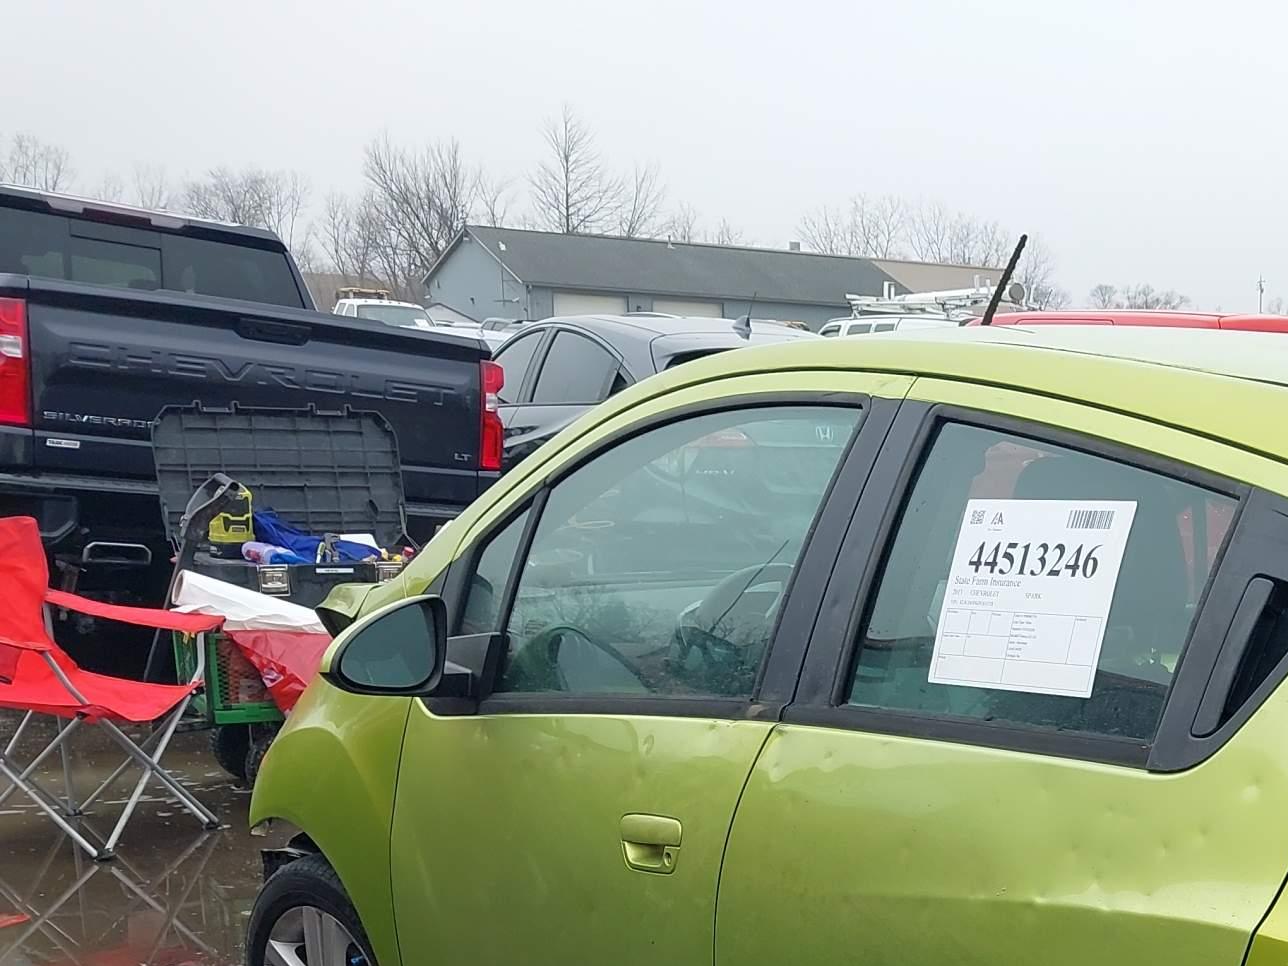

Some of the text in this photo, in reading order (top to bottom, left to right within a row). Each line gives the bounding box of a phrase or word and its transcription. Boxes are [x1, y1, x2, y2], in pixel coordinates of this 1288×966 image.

[69, 341, 457, 406] CHEVROLET
[454, 453, 472, 461] LT
[968, 541, 1103, 579] 44513246
[955, 575, 1021, 587] State Farm Insurance
